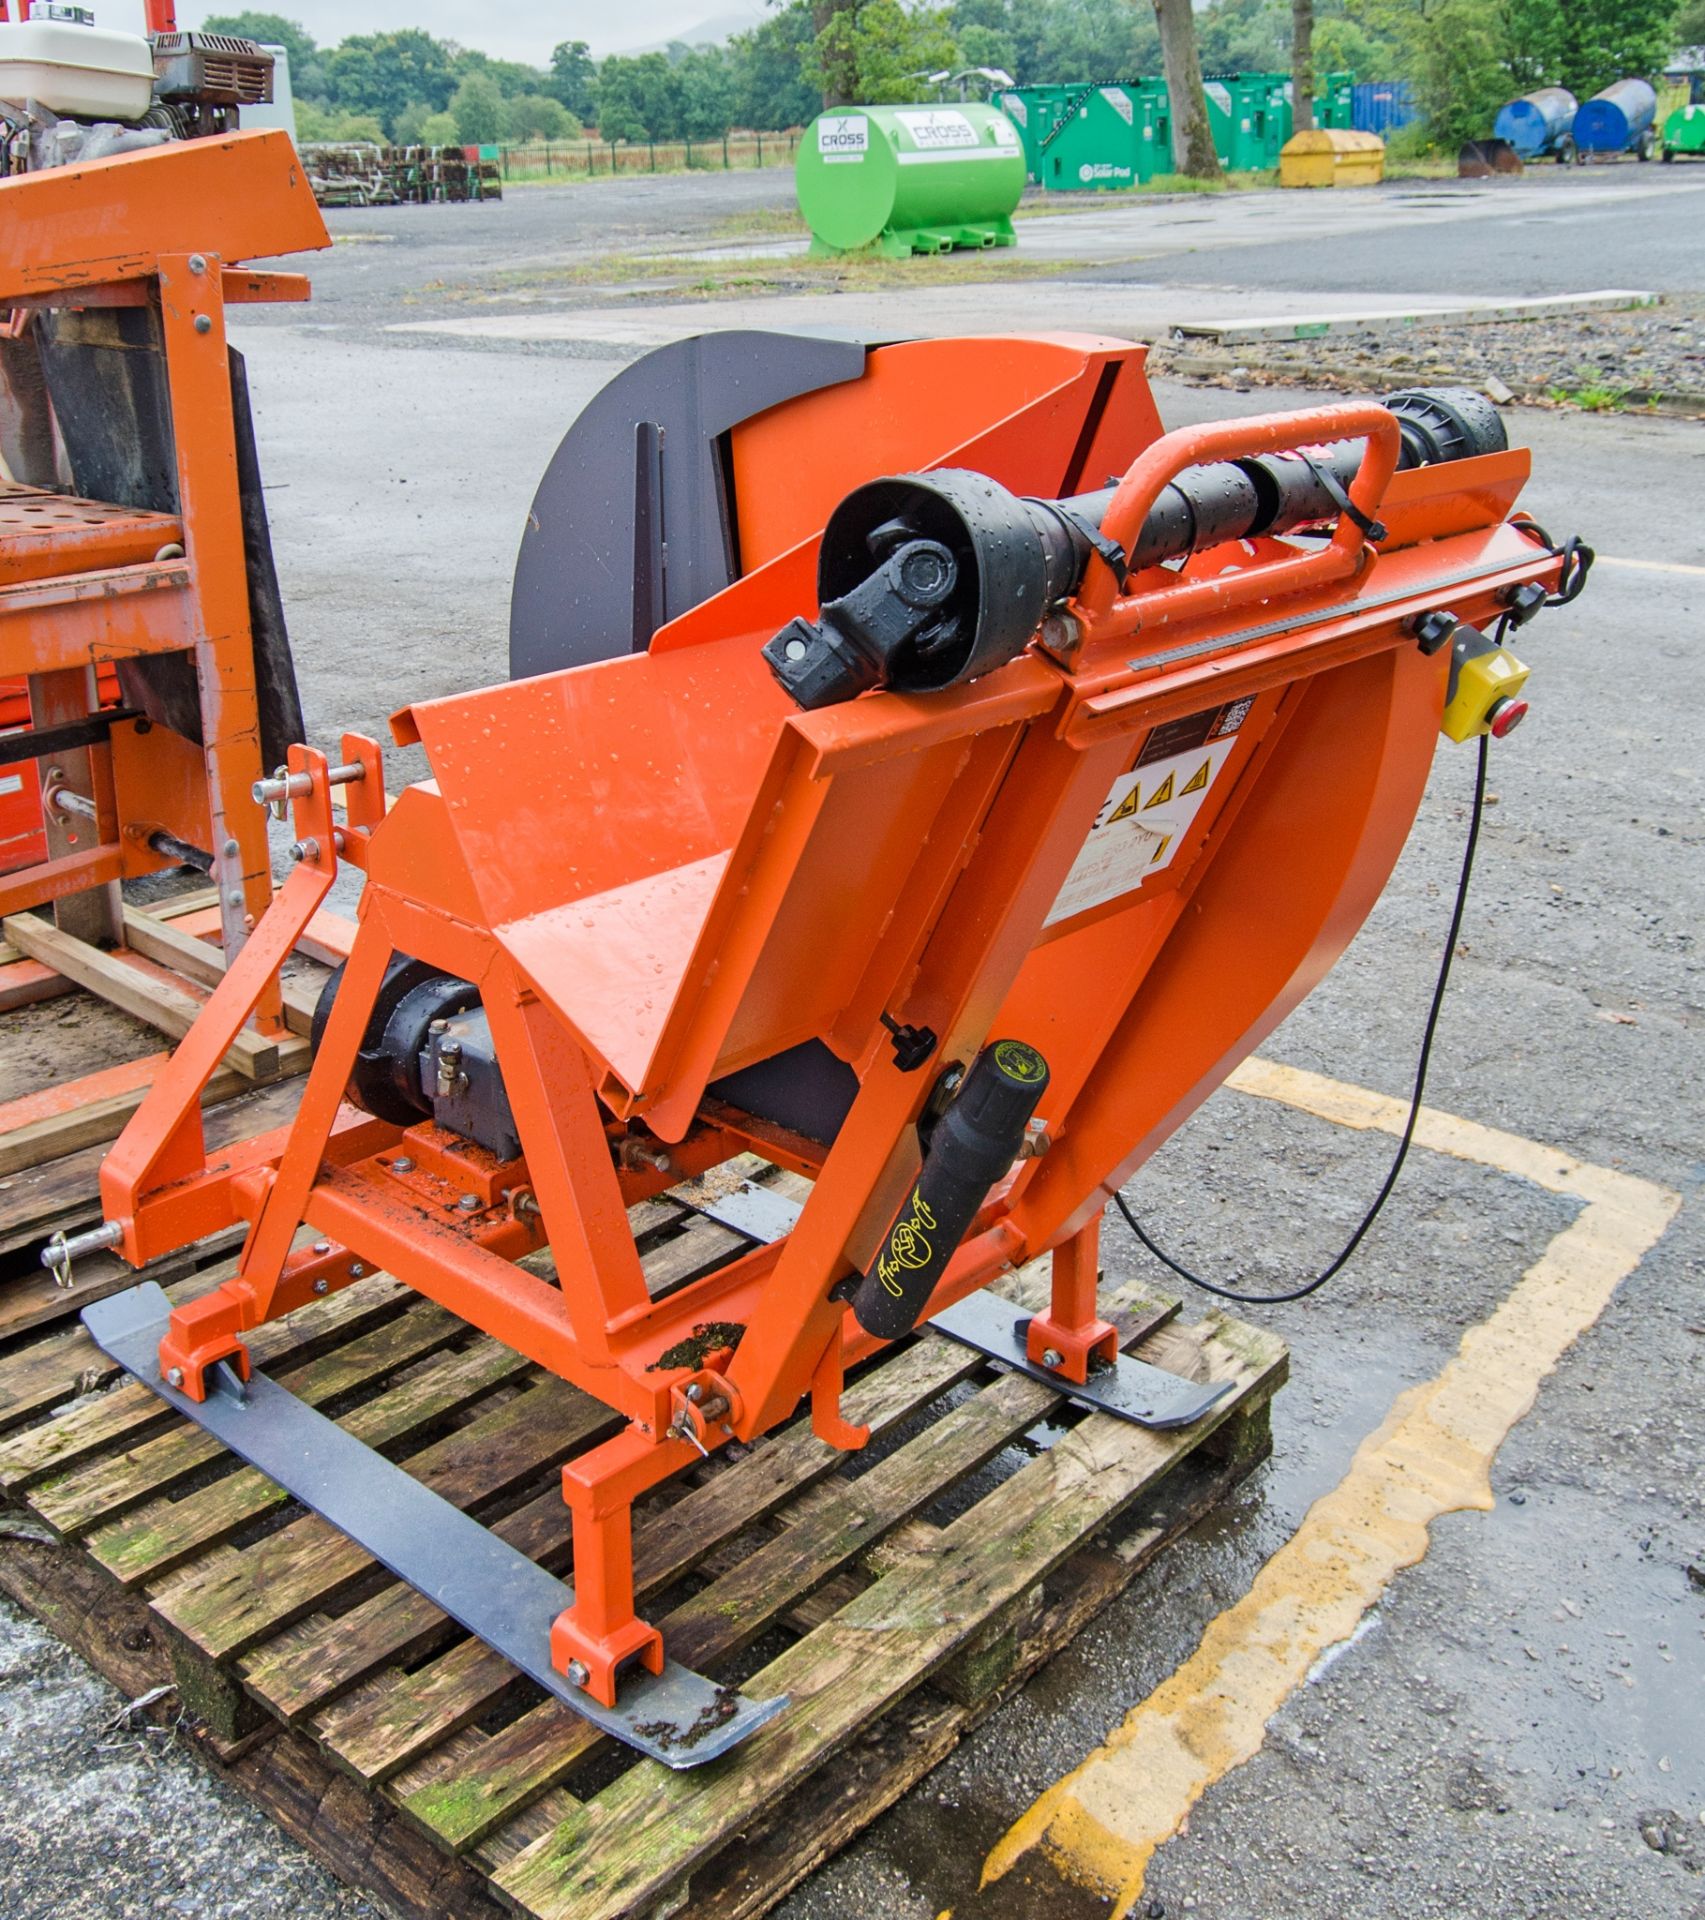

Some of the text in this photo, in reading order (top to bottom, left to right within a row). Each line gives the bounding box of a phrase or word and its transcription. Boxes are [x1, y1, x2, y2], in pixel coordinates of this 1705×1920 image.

[913, 125, 971, 138] CROSS
[822, 133, 865, 146] CROSS
[1094, 167, 1130, 177] Solar Pod
